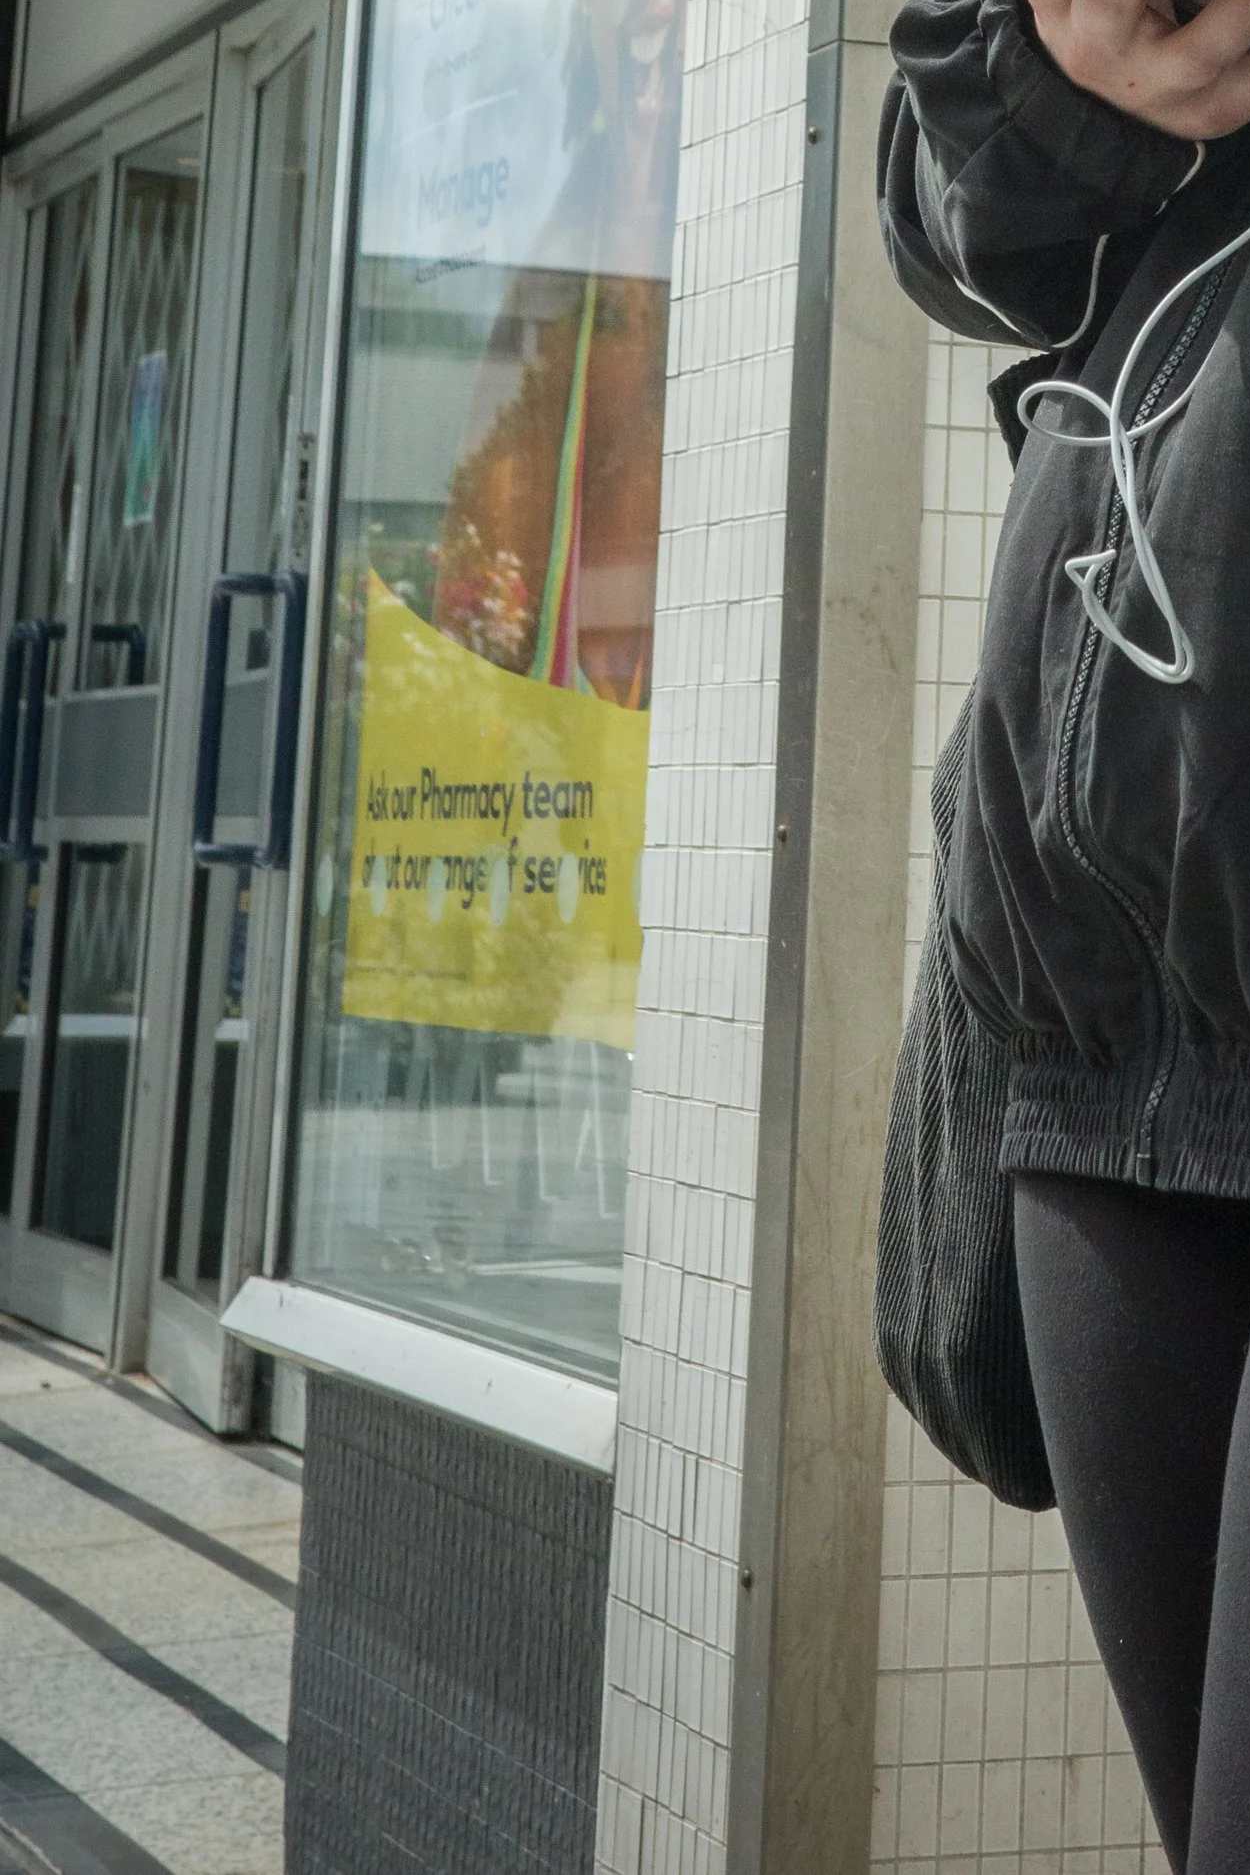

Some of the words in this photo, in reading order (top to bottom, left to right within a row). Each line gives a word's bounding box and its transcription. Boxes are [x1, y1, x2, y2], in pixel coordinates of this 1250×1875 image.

[416, 154, 511, 232] Manage
[366, 768, 389, 821] Ask
[391, 783, 417, 821] our
[419, 765, 516, 836] Pharmacy
[522, 770, 594, 820] team
[362, 837, 401, 890] abut
[403, 855, 432, 890] our
[434, 855, 489, 910] ange
